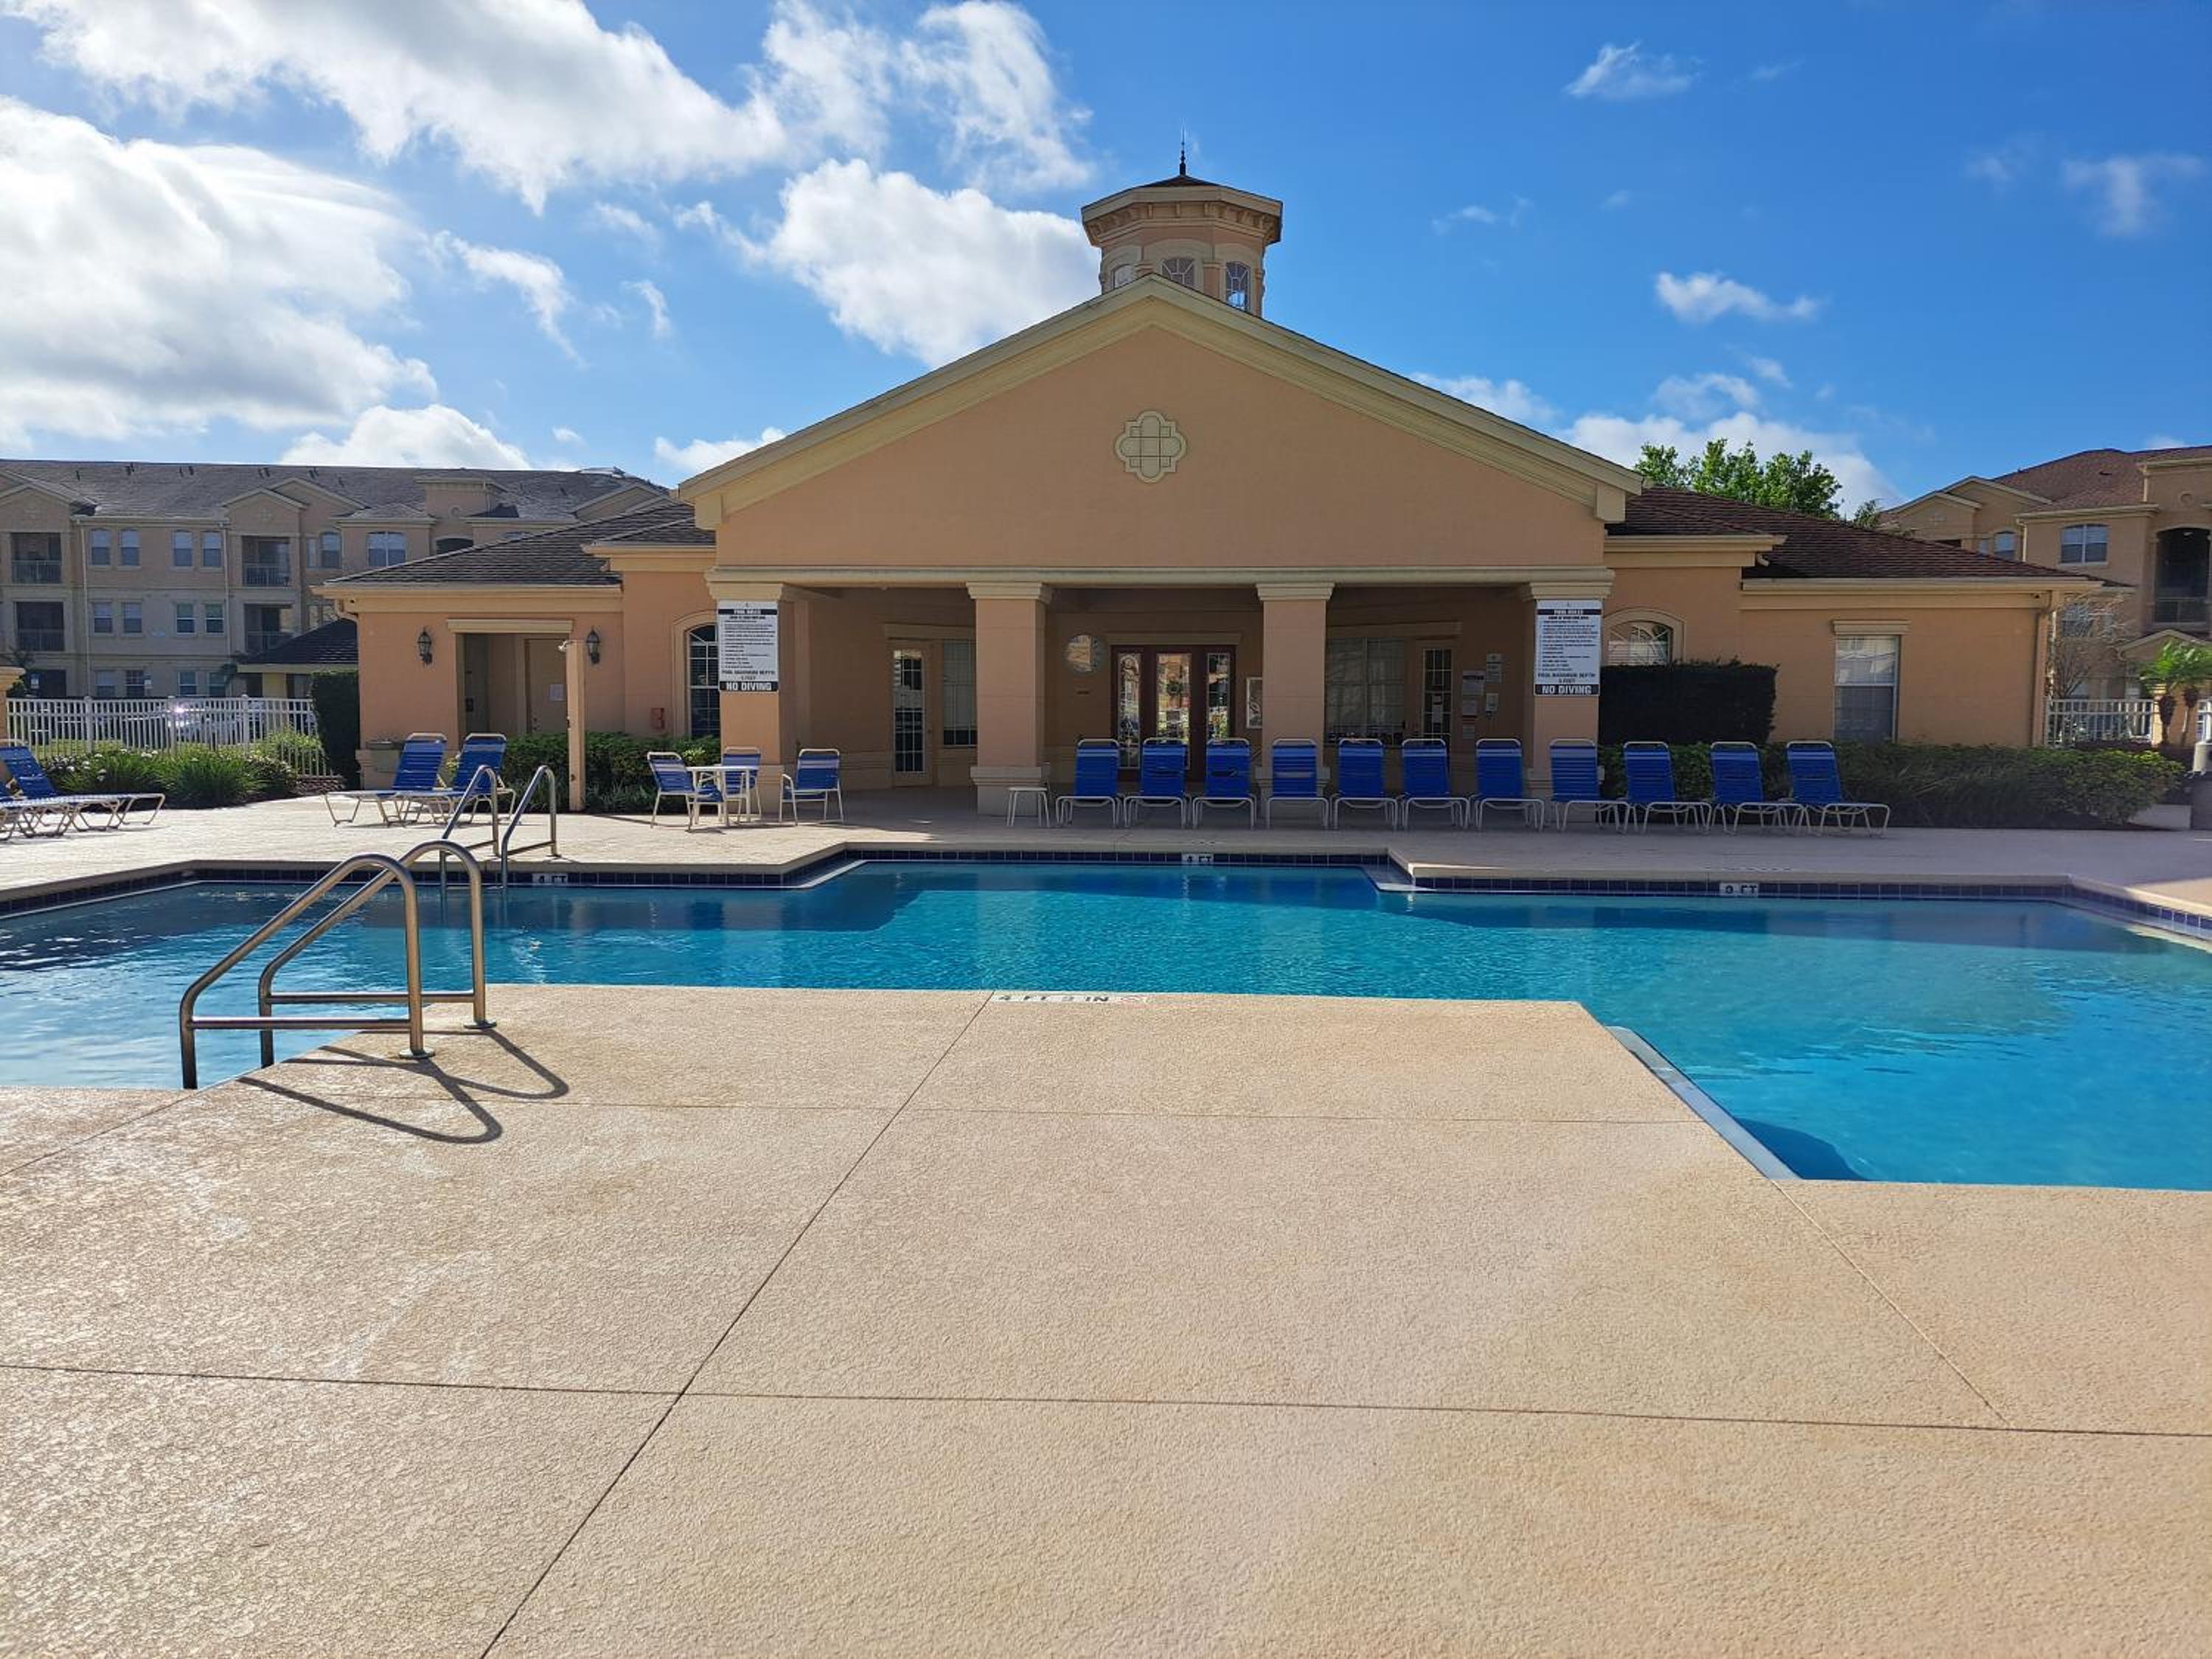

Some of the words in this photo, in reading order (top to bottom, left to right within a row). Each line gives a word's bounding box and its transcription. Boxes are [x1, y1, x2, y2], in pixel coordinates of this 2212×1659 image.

[726, 682, 738, 691] NO
[741, 682, 772, 691] DIVING
[1542, 685, 1556, 694] NO
[1558, 685, 1592, 694] DIVING
[552, 875, 567, 884] FT
[1741, 885, 1757, 894] FT
